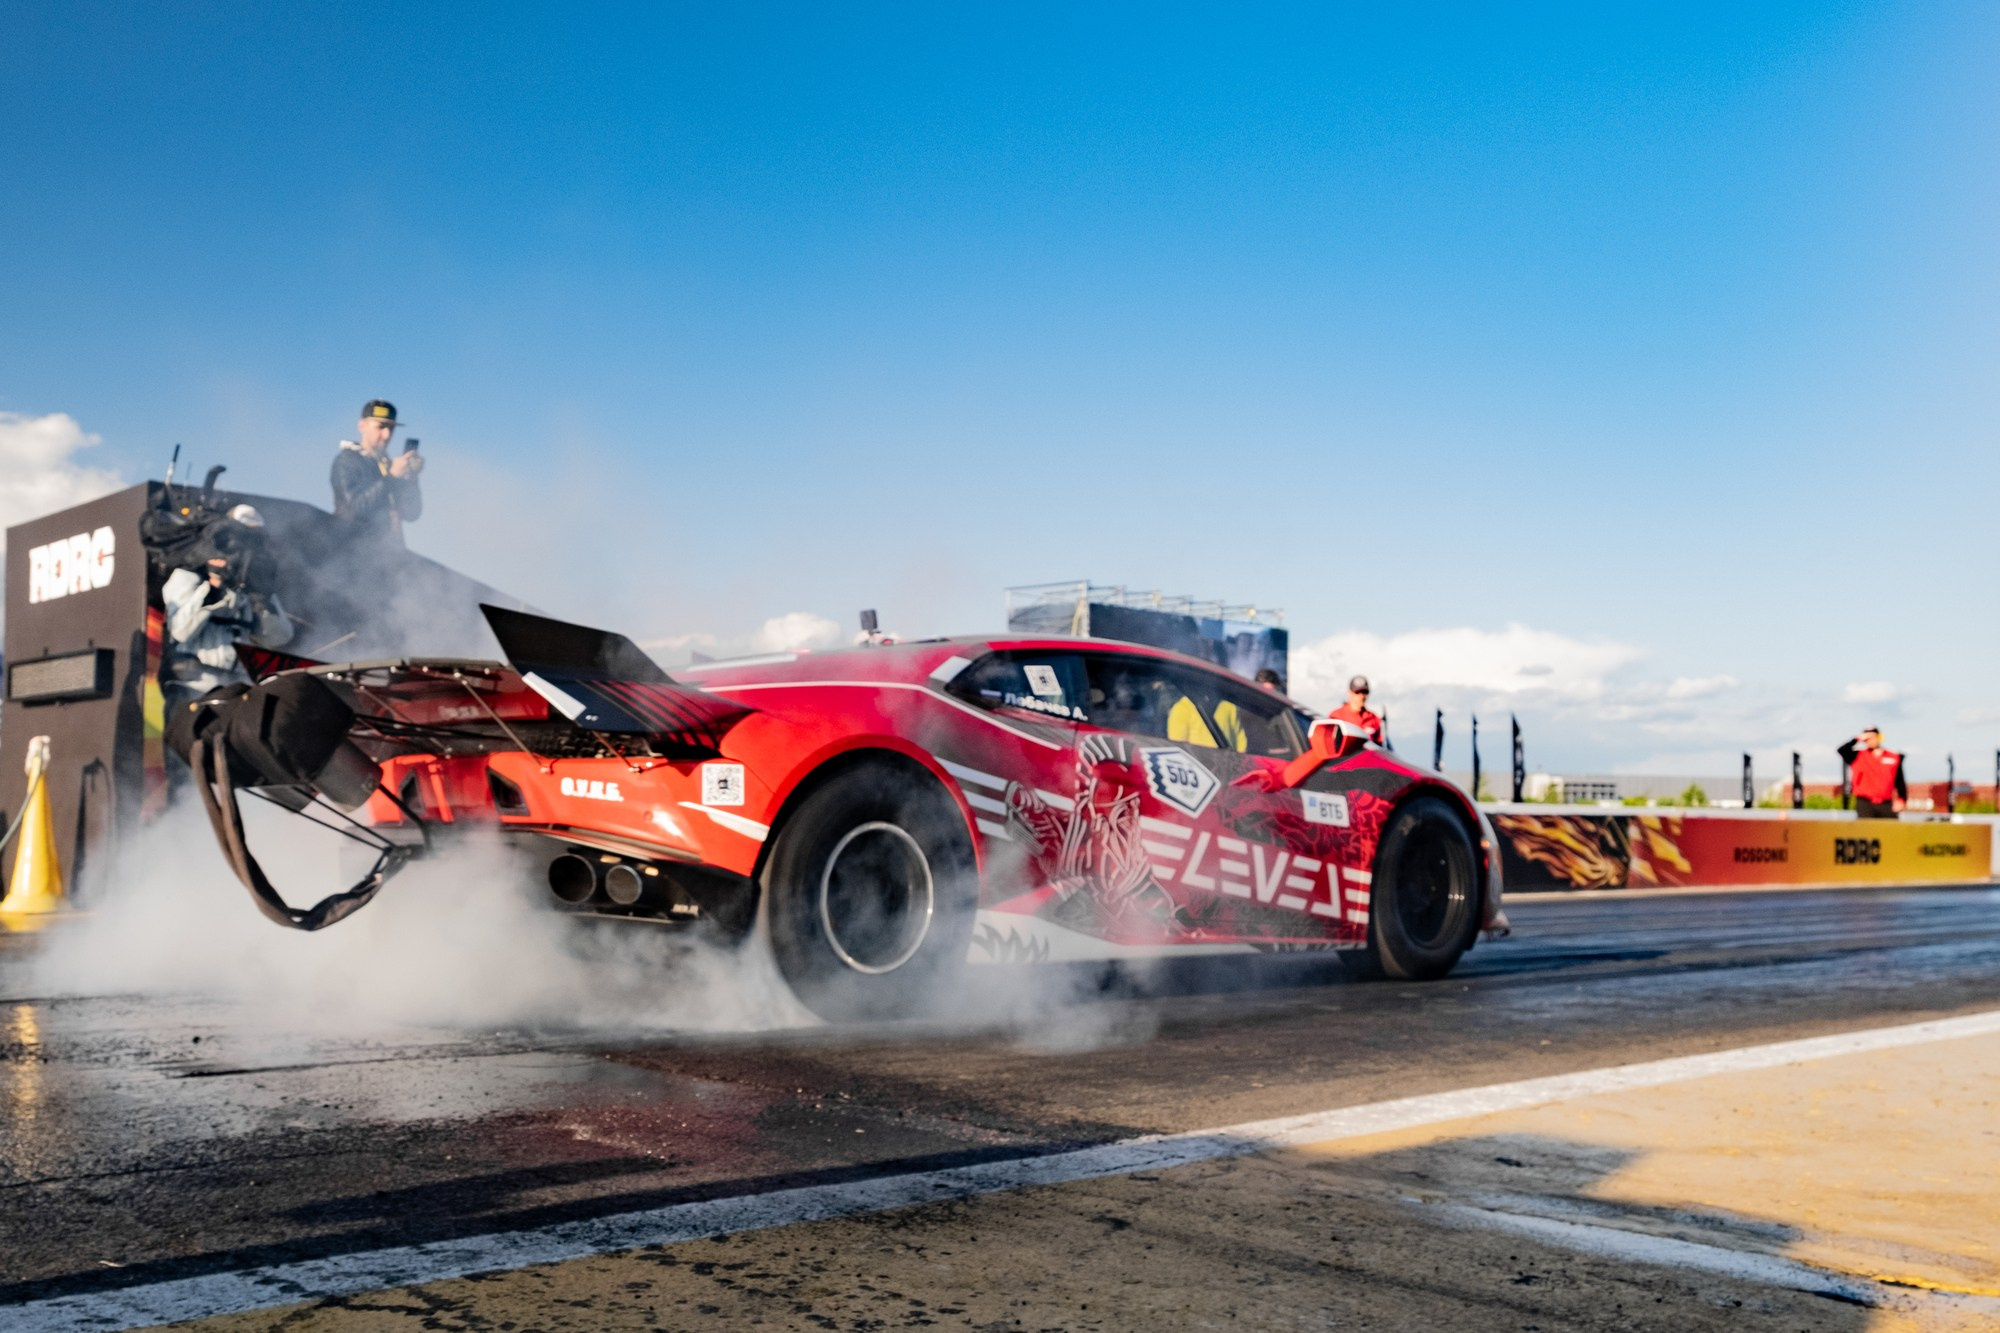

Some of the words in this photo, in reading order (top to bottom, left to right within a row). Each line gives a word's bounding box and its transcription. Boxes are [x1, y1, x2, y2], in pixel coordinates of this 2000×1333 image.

[28, 526, 115, 604] RDRC
[1166, 765, 1199, 788] 503
[1319, 801, 1344, 820] ВТБ
[1834, 838, 1881, 864] RDRC
